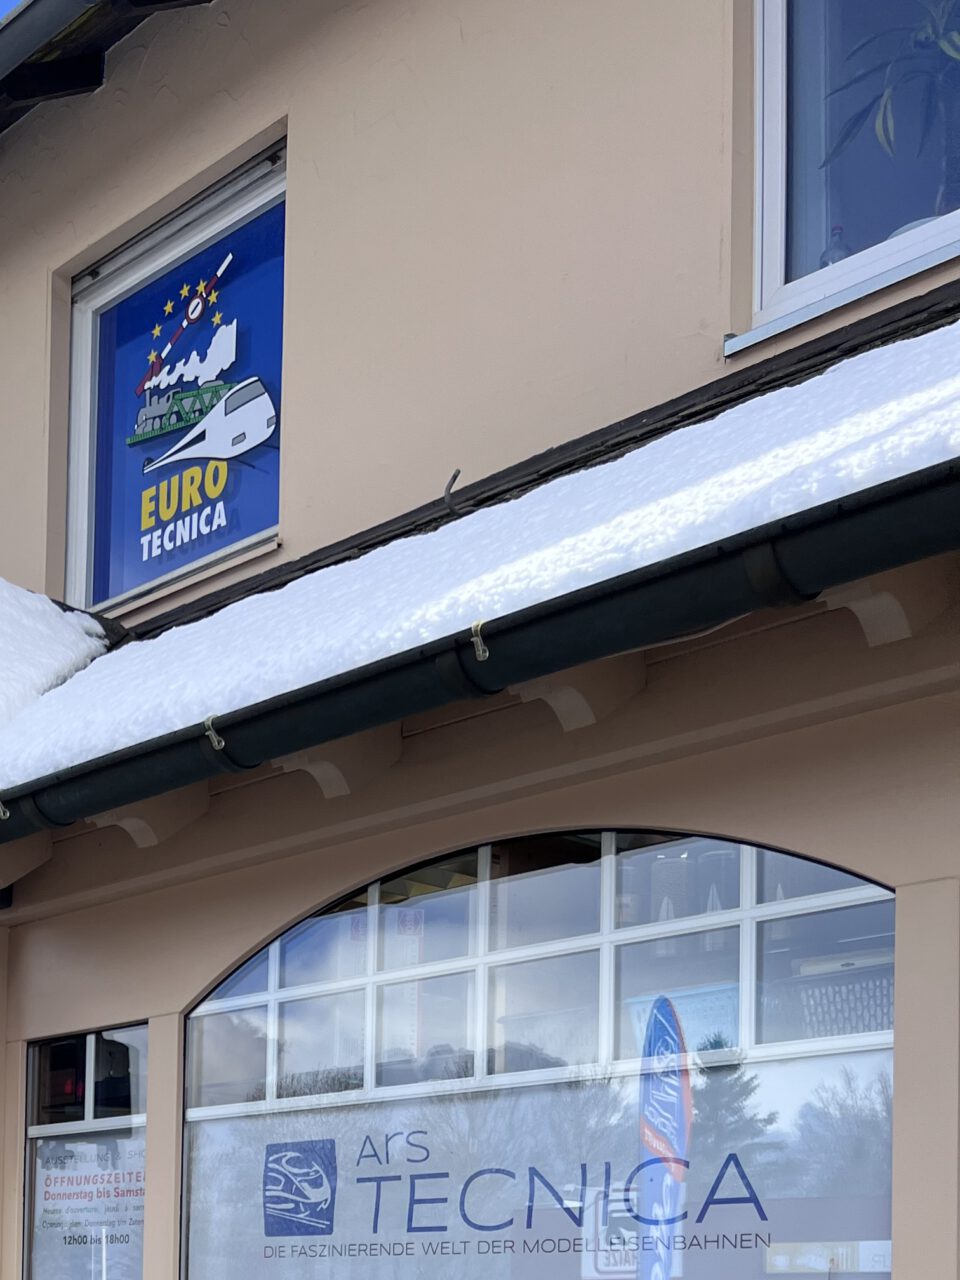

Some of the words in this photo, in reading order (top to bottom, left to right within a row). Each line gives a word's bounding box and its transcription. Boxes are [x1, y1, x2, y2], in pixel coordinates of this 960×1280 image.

[140, 459, 228, 531] EURO
[140, 500, 227, 562] TECNICA
[45, 1152, 110, 1165] AUSSTELLUNG
[43, 1190, 93, 1202] Donnerstag
[96, 1187, 111, 1198] bis
[356, 1153, 769, 1233] TECNICA
[62, 1234, 88, 1245] 12h00
[89, 1234, 102, 1245] bis
[105, 1233, 130, 1244] 18h00
[263, 1245, 286, 1258] DIE
[290, 1242, 415, 1258] FASZINIERENDE
[421, 1240, 471, 1255] WELT
[477, 1240, 515, 1254] DER
[522, 1232, 772, 1254] MODELLEISENBAHNEN
